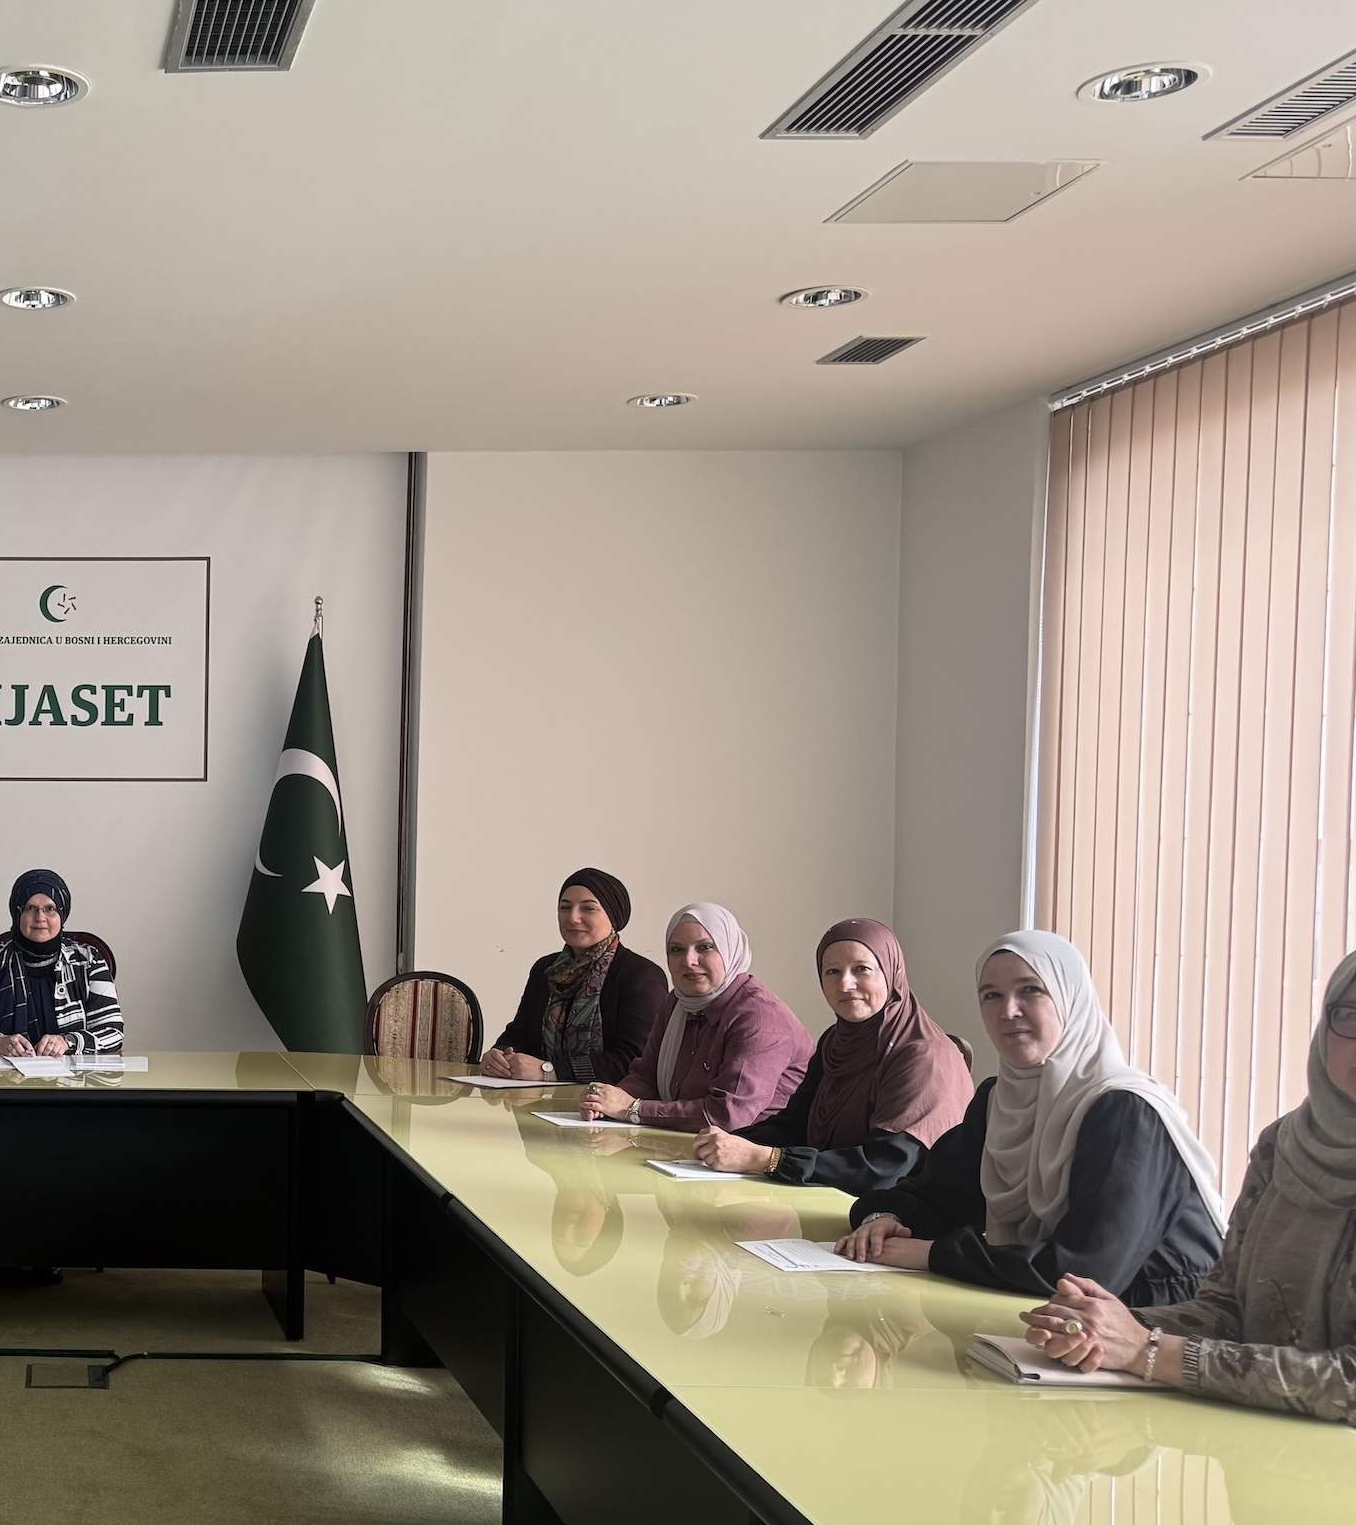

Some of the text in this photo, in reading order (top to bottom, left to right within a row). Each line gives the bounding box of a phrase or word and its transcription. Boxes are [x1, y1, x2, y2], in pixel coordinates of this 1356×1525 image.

[55, 636, 63, 645] U
[65, 636, 95, 645] BOSNI
[103, 636, 173, 646] HERCEGOVINI
